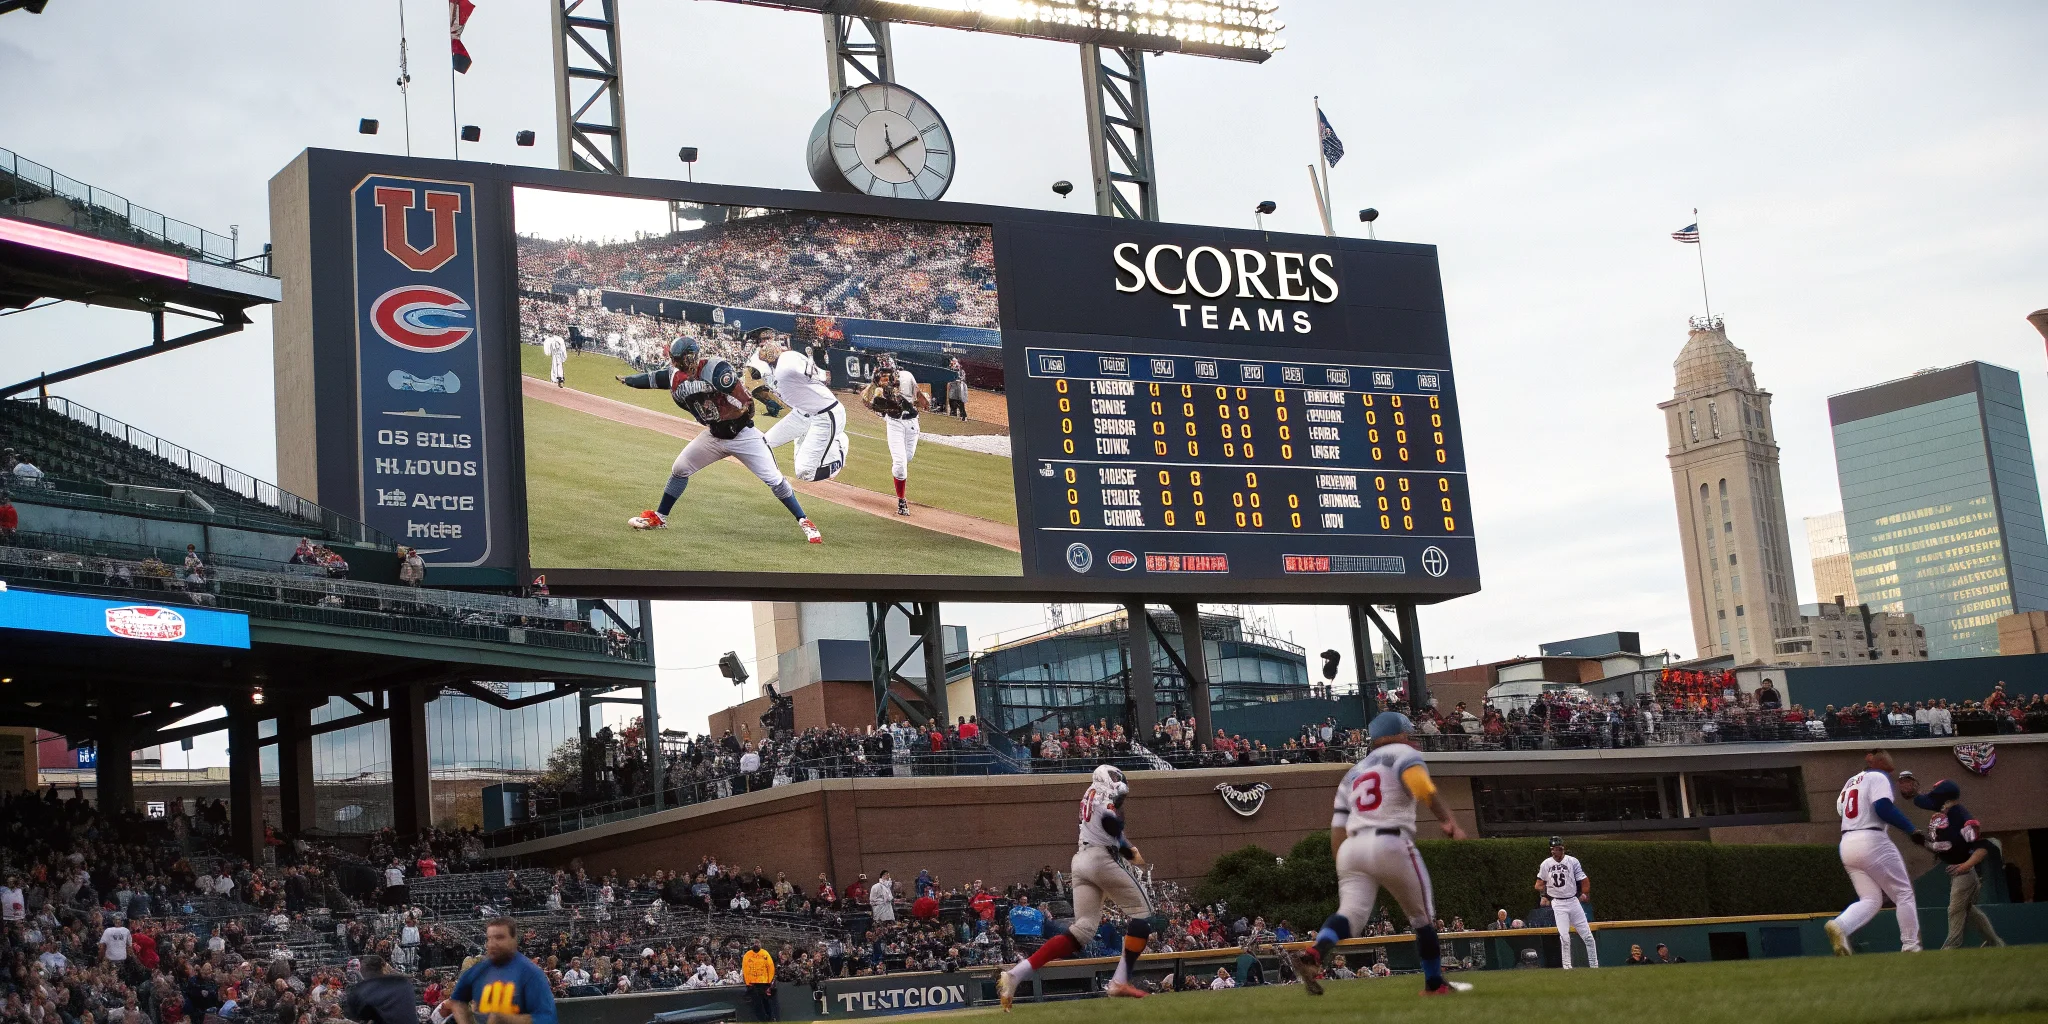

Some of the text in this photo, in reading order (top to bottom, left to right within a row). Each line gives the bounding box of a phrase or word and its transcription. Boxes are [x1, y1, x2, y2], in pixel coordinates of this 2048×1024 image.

[375, 185, 462, 273] U
[1113, 242, 1339, 304] SCORES
[1172, 303, 1312, 334] TEAMS
[1353, 771, 1382, 812] 3
